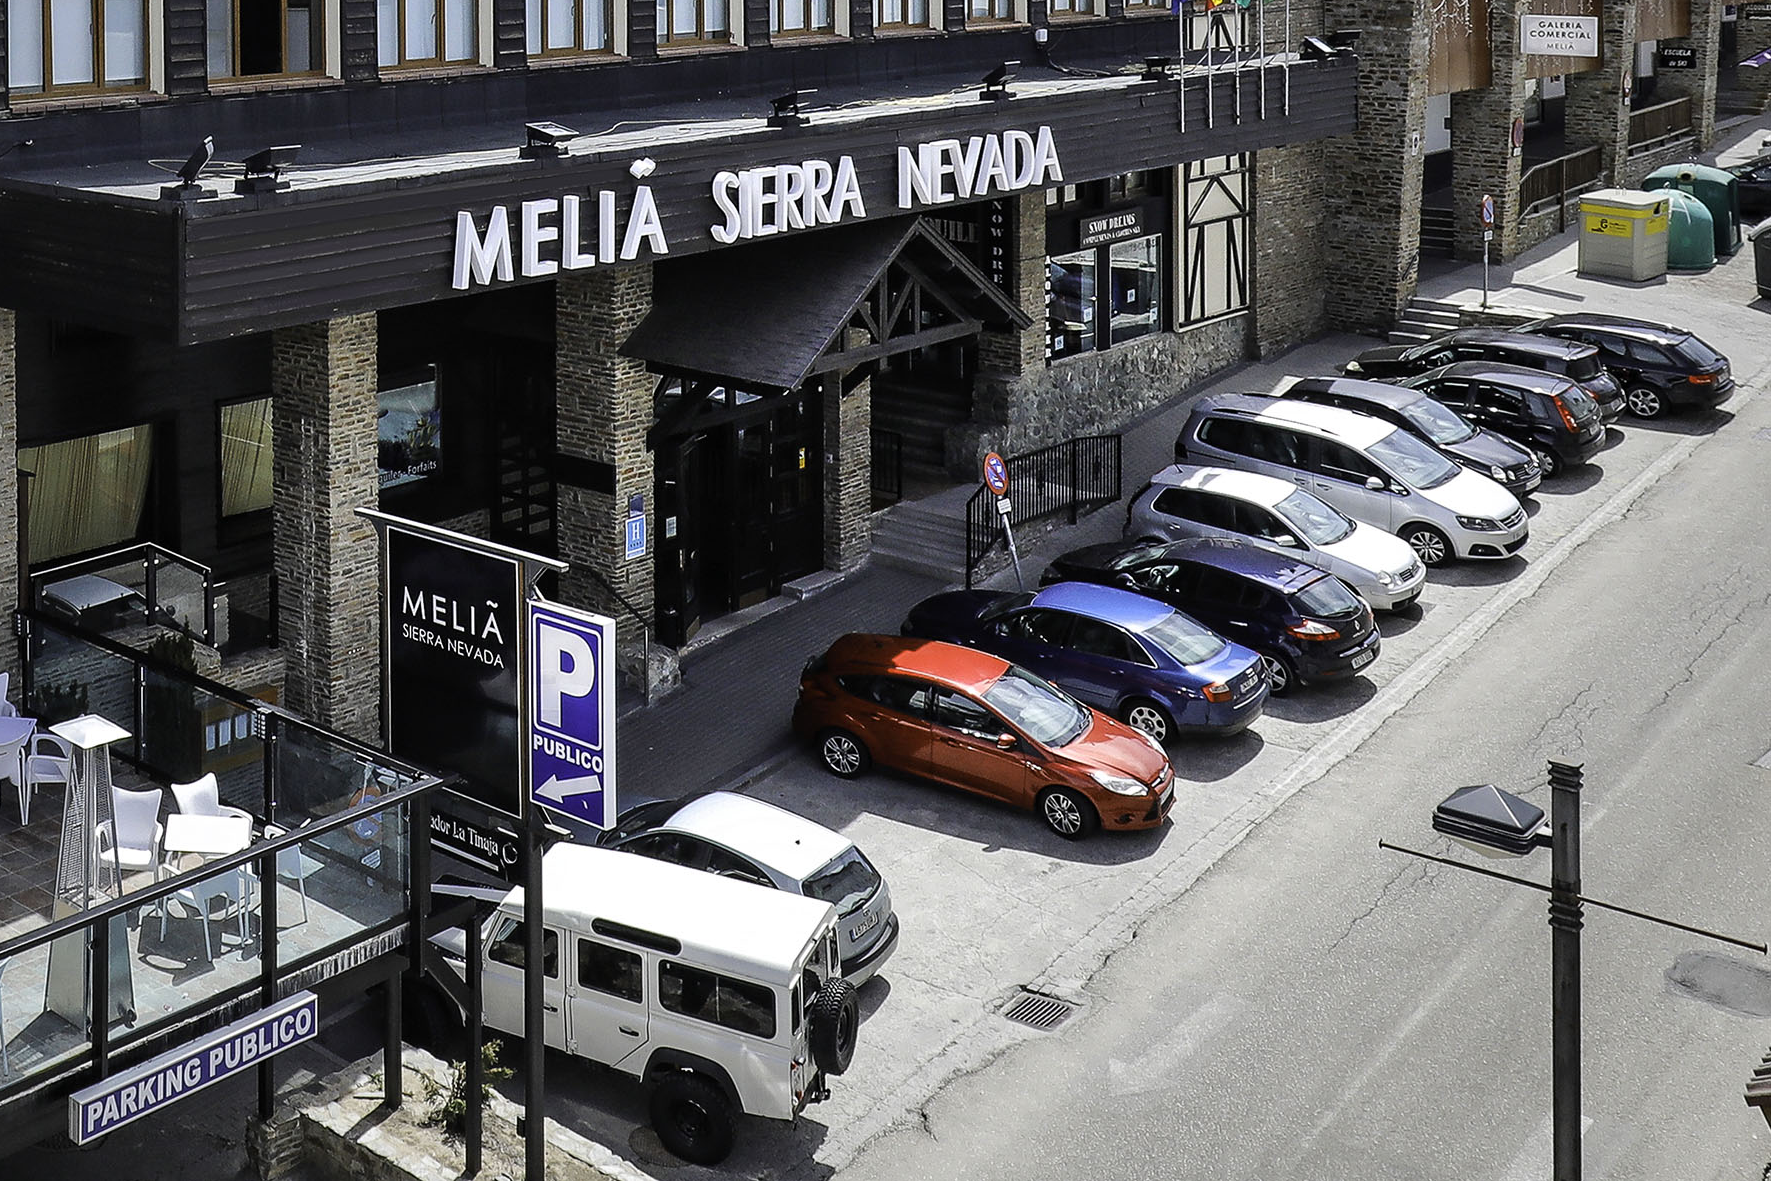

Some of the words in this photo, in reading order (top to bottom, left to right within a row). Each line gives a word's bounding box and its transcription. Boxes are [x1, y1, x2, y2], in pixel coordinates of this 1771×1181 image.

[1529, 30, 1592, 39] COMERCIAL
[1538, 20, 1583, 30] GALERIA
[1664, 49, 1692, 57] ESCUELA
[710, 155, 866, 244] SIERRA
[898, 126, 1062, 208] NEVADA
[1088, 218, 1108, 234] SNOW
[1109, 213, 1136, 230] DREAMS
[1044, 255, 1052, 358] ALQUILER
[407, 460, 437, 475] Forfaits
[632, 522, 640, 541] H
[402, 623, 444, 651] SIERRA
[447, 638, 504, 669] NEVADA
[540, 622, 595, 728] P
[533, 733, 603, 774] PUBLICO
[453, 821, 466, 842] La
[467, 826, 499, 856] Tinaja
[87, 1057, 202, 1133] PARKING
[209, 1007, 312, 1077] PUBLICO
